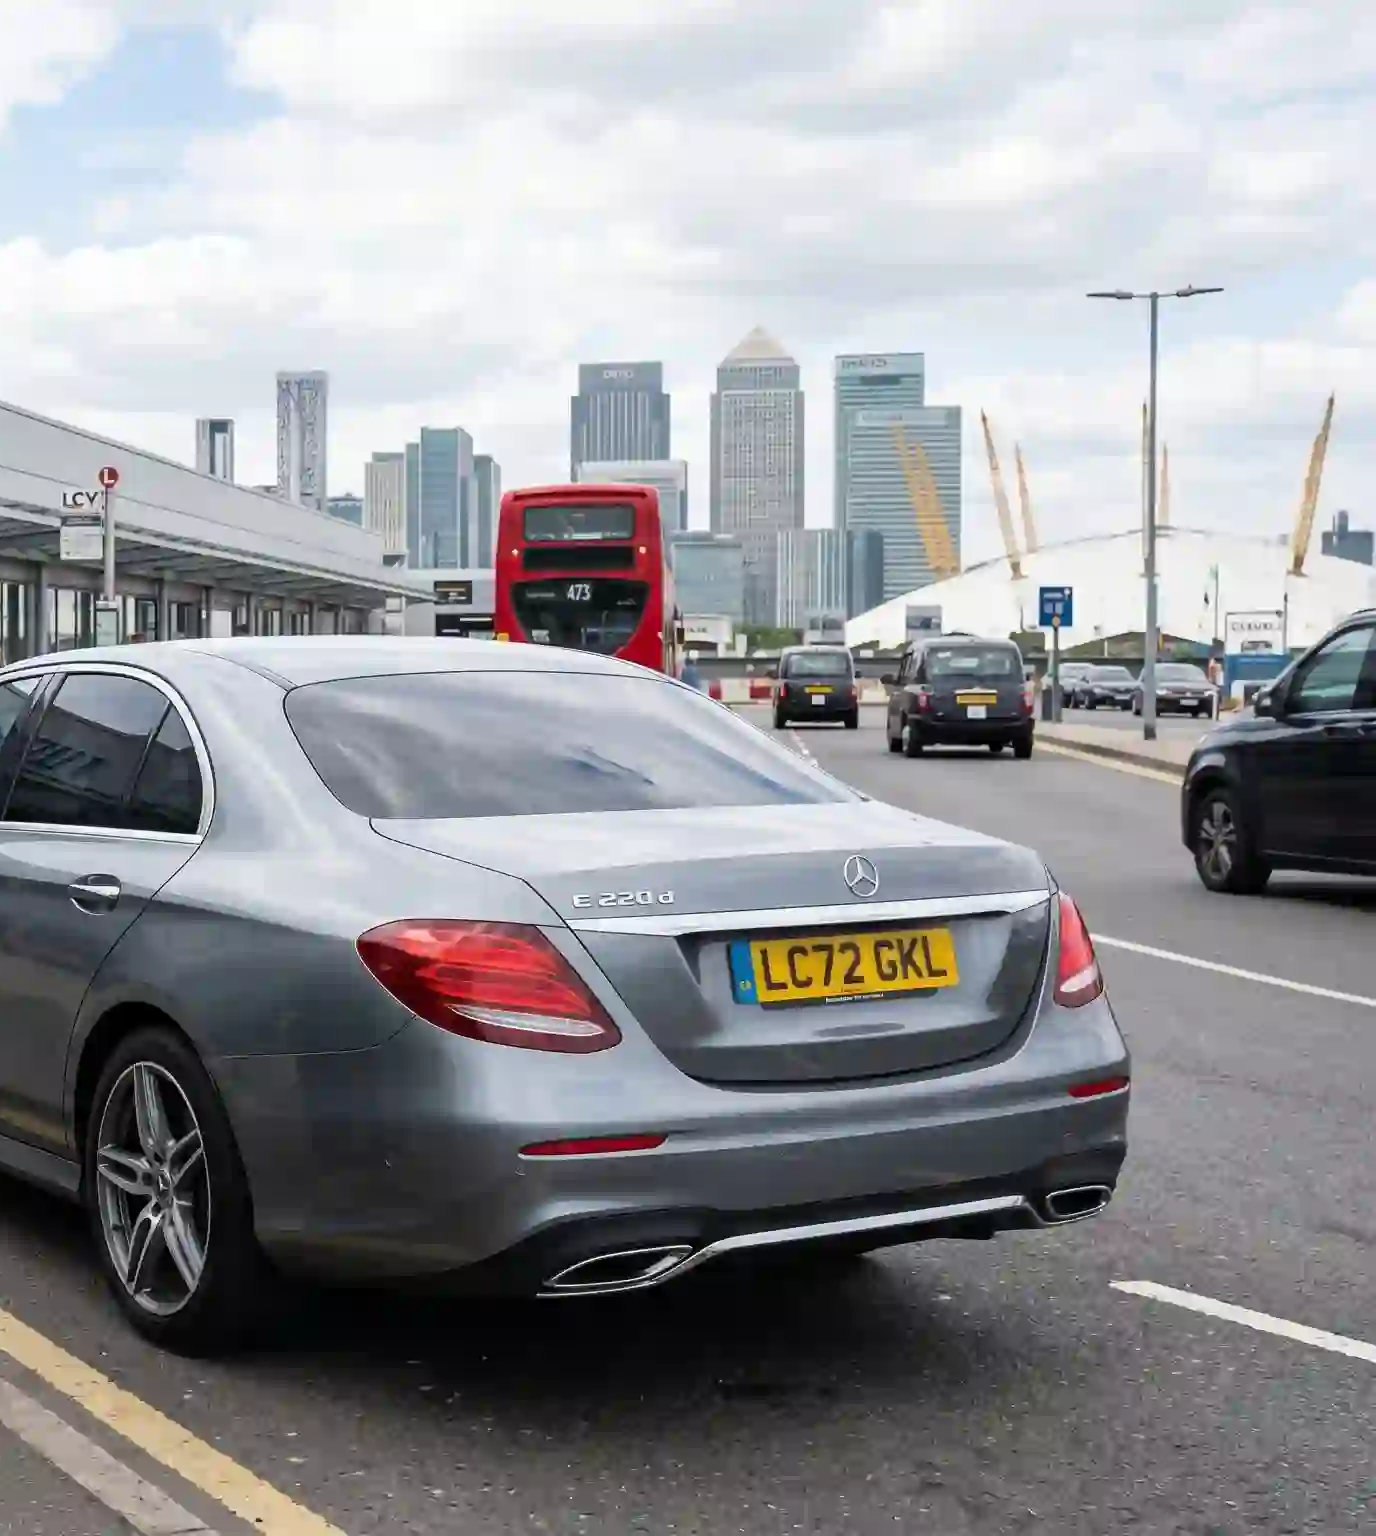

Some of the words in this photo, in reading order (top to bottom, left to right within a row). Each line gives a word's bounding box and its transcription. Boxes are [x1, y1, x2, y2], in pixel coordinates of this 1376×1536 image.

[62, 491, 99, 508] LCY
[572, 894, 592, 908] E
[598, 890, 653, 907] 220
[658, 889, 675, 905] d
[760, 941, 865, 991] LC72
[874, 935, 948, 982] GKL
